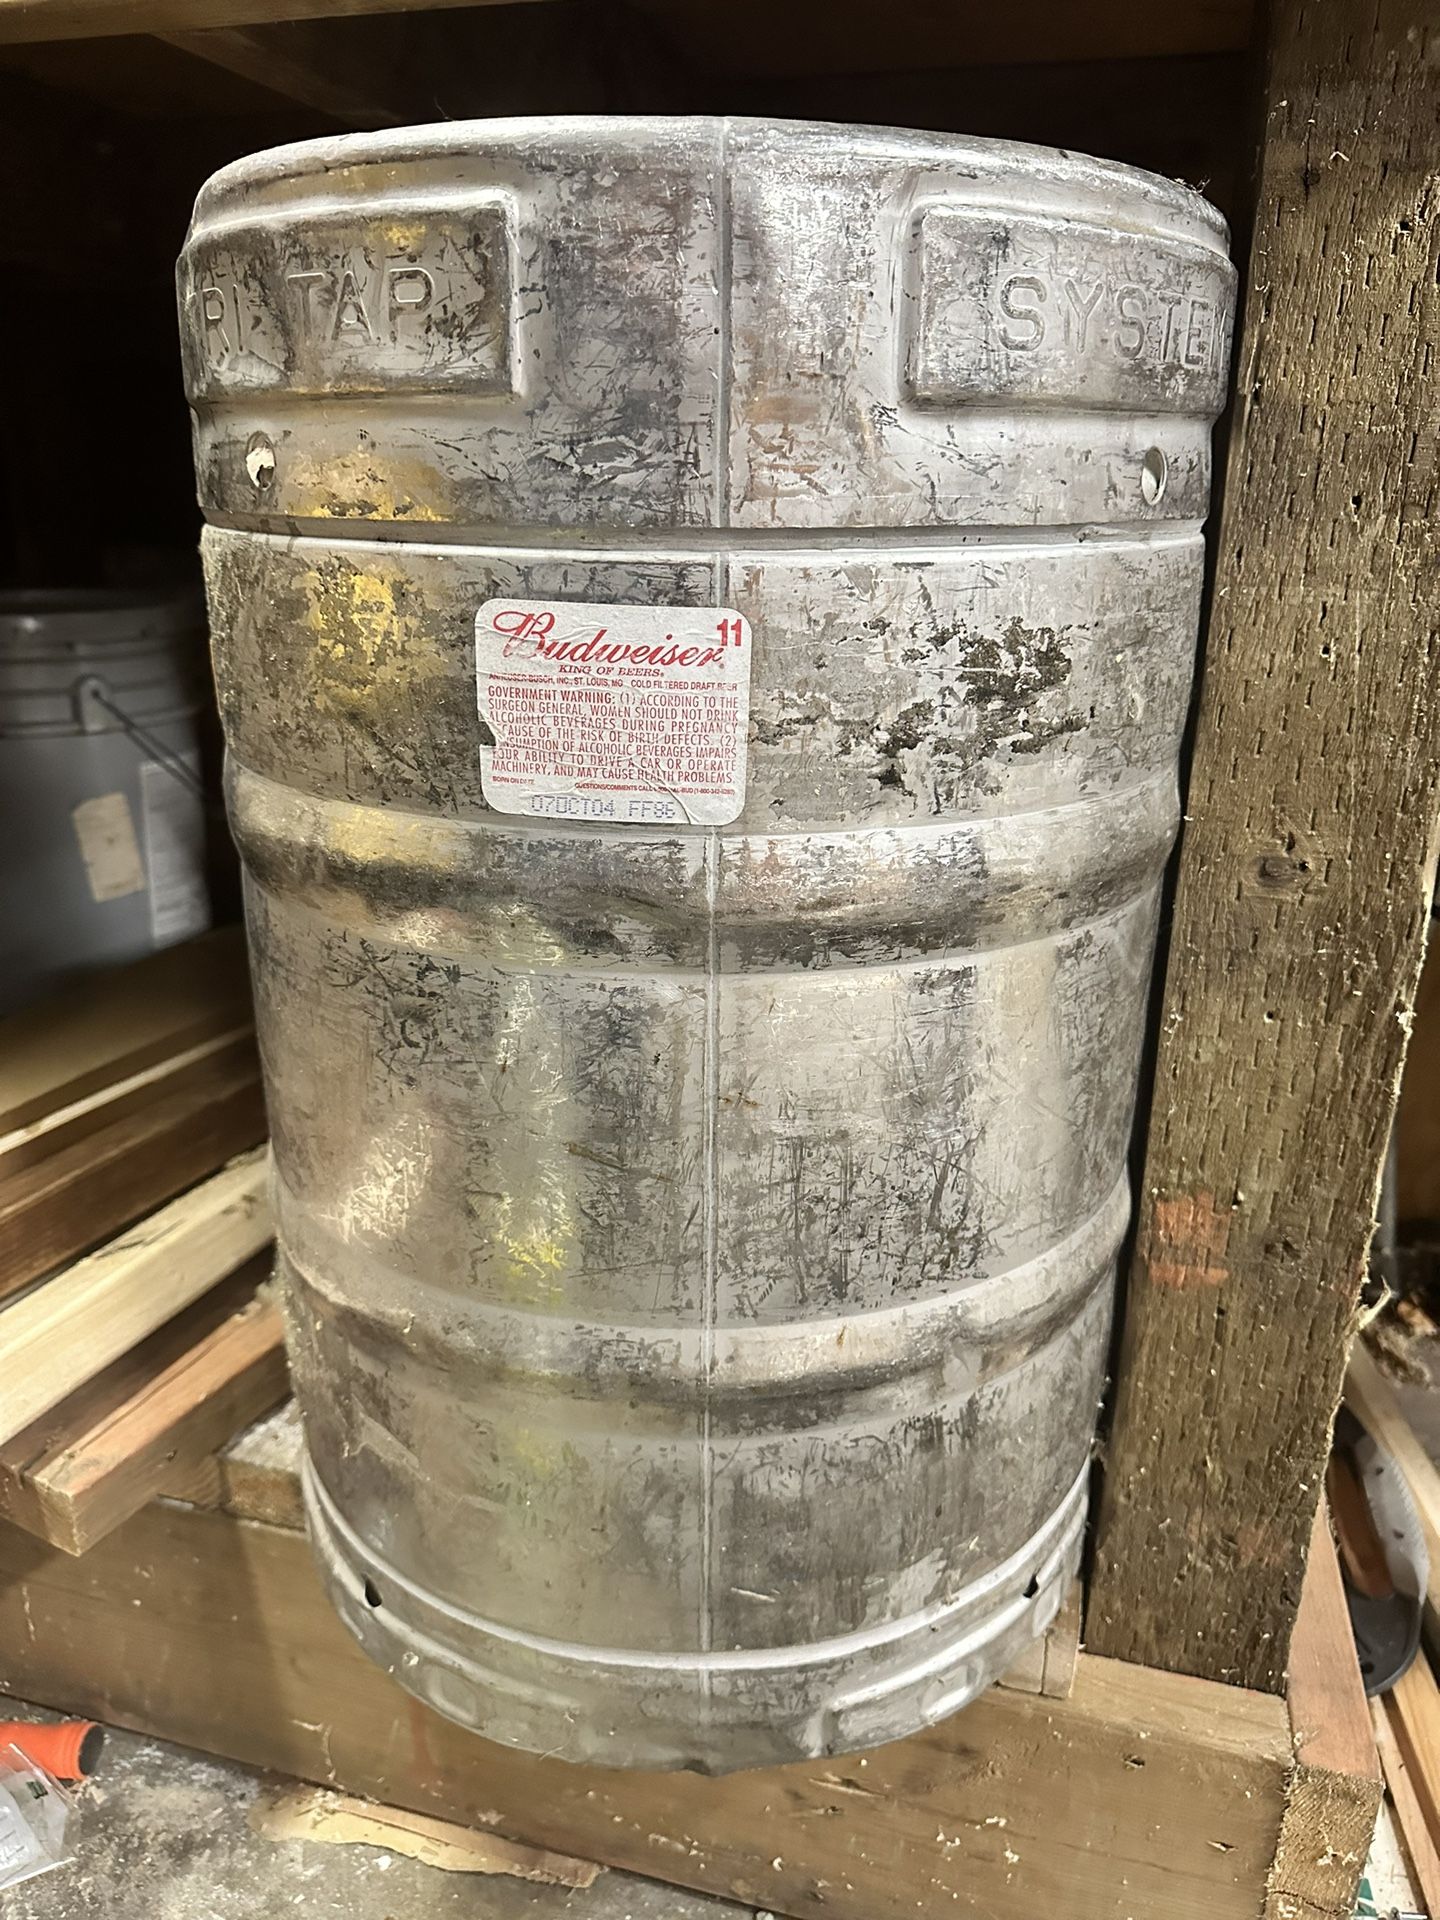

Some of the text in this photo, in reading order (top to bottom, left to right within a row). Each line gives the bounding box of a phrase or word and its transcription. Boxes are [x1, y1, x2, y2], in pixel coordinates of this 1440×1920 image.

[286, 269, 435, 345] TAP
[493, 611, 724, 666] Budweiser
[717, 619, 742, 646] 11
[558, 664, 592, 675] KING
[596, 666, 614, 676] OF
[488, 685, 738, 709] GOVERNMENT WARNING: (1) ACCORDING TO THE
[631, 680, 652, 689] COLD
[690, 682, 715, 691] DRAFT
[488, 698, 738, 722] SURGEON GENERAL, WOMEN SHOULD NOT DRINK
[489, 711, 738, 735] ALCOHOLIC BEVERAGES DURING PREGNANCY
[539, 727, 552, 739] OF
[557, 728, 576, 740] THE
[581, 729, 606, 742] RISK
[610, 731, 622, 742] OF
[628, 732, 659, 745] BIRTH
[720, 735, 737, 747] (2)
[492, 749, 736, 772] YOUR ABILITY TO DRIVE A CAR OR OPERATE
[562, 740, 575, 752] OF
[579, 742, 634, 755] ALCOHOLIC
[636, 744, 692, 758] BEVERAGES
[696, 746, 737, 760] IMPAIRS
[492, 760, 551, 776] MACHINERY,
[554, 764, 574, 777] AND
[577, 766, 598, 778] MAY
[602, 768, 634, 780] CAUSE
[637, 769, 674, 782] HEALTH
